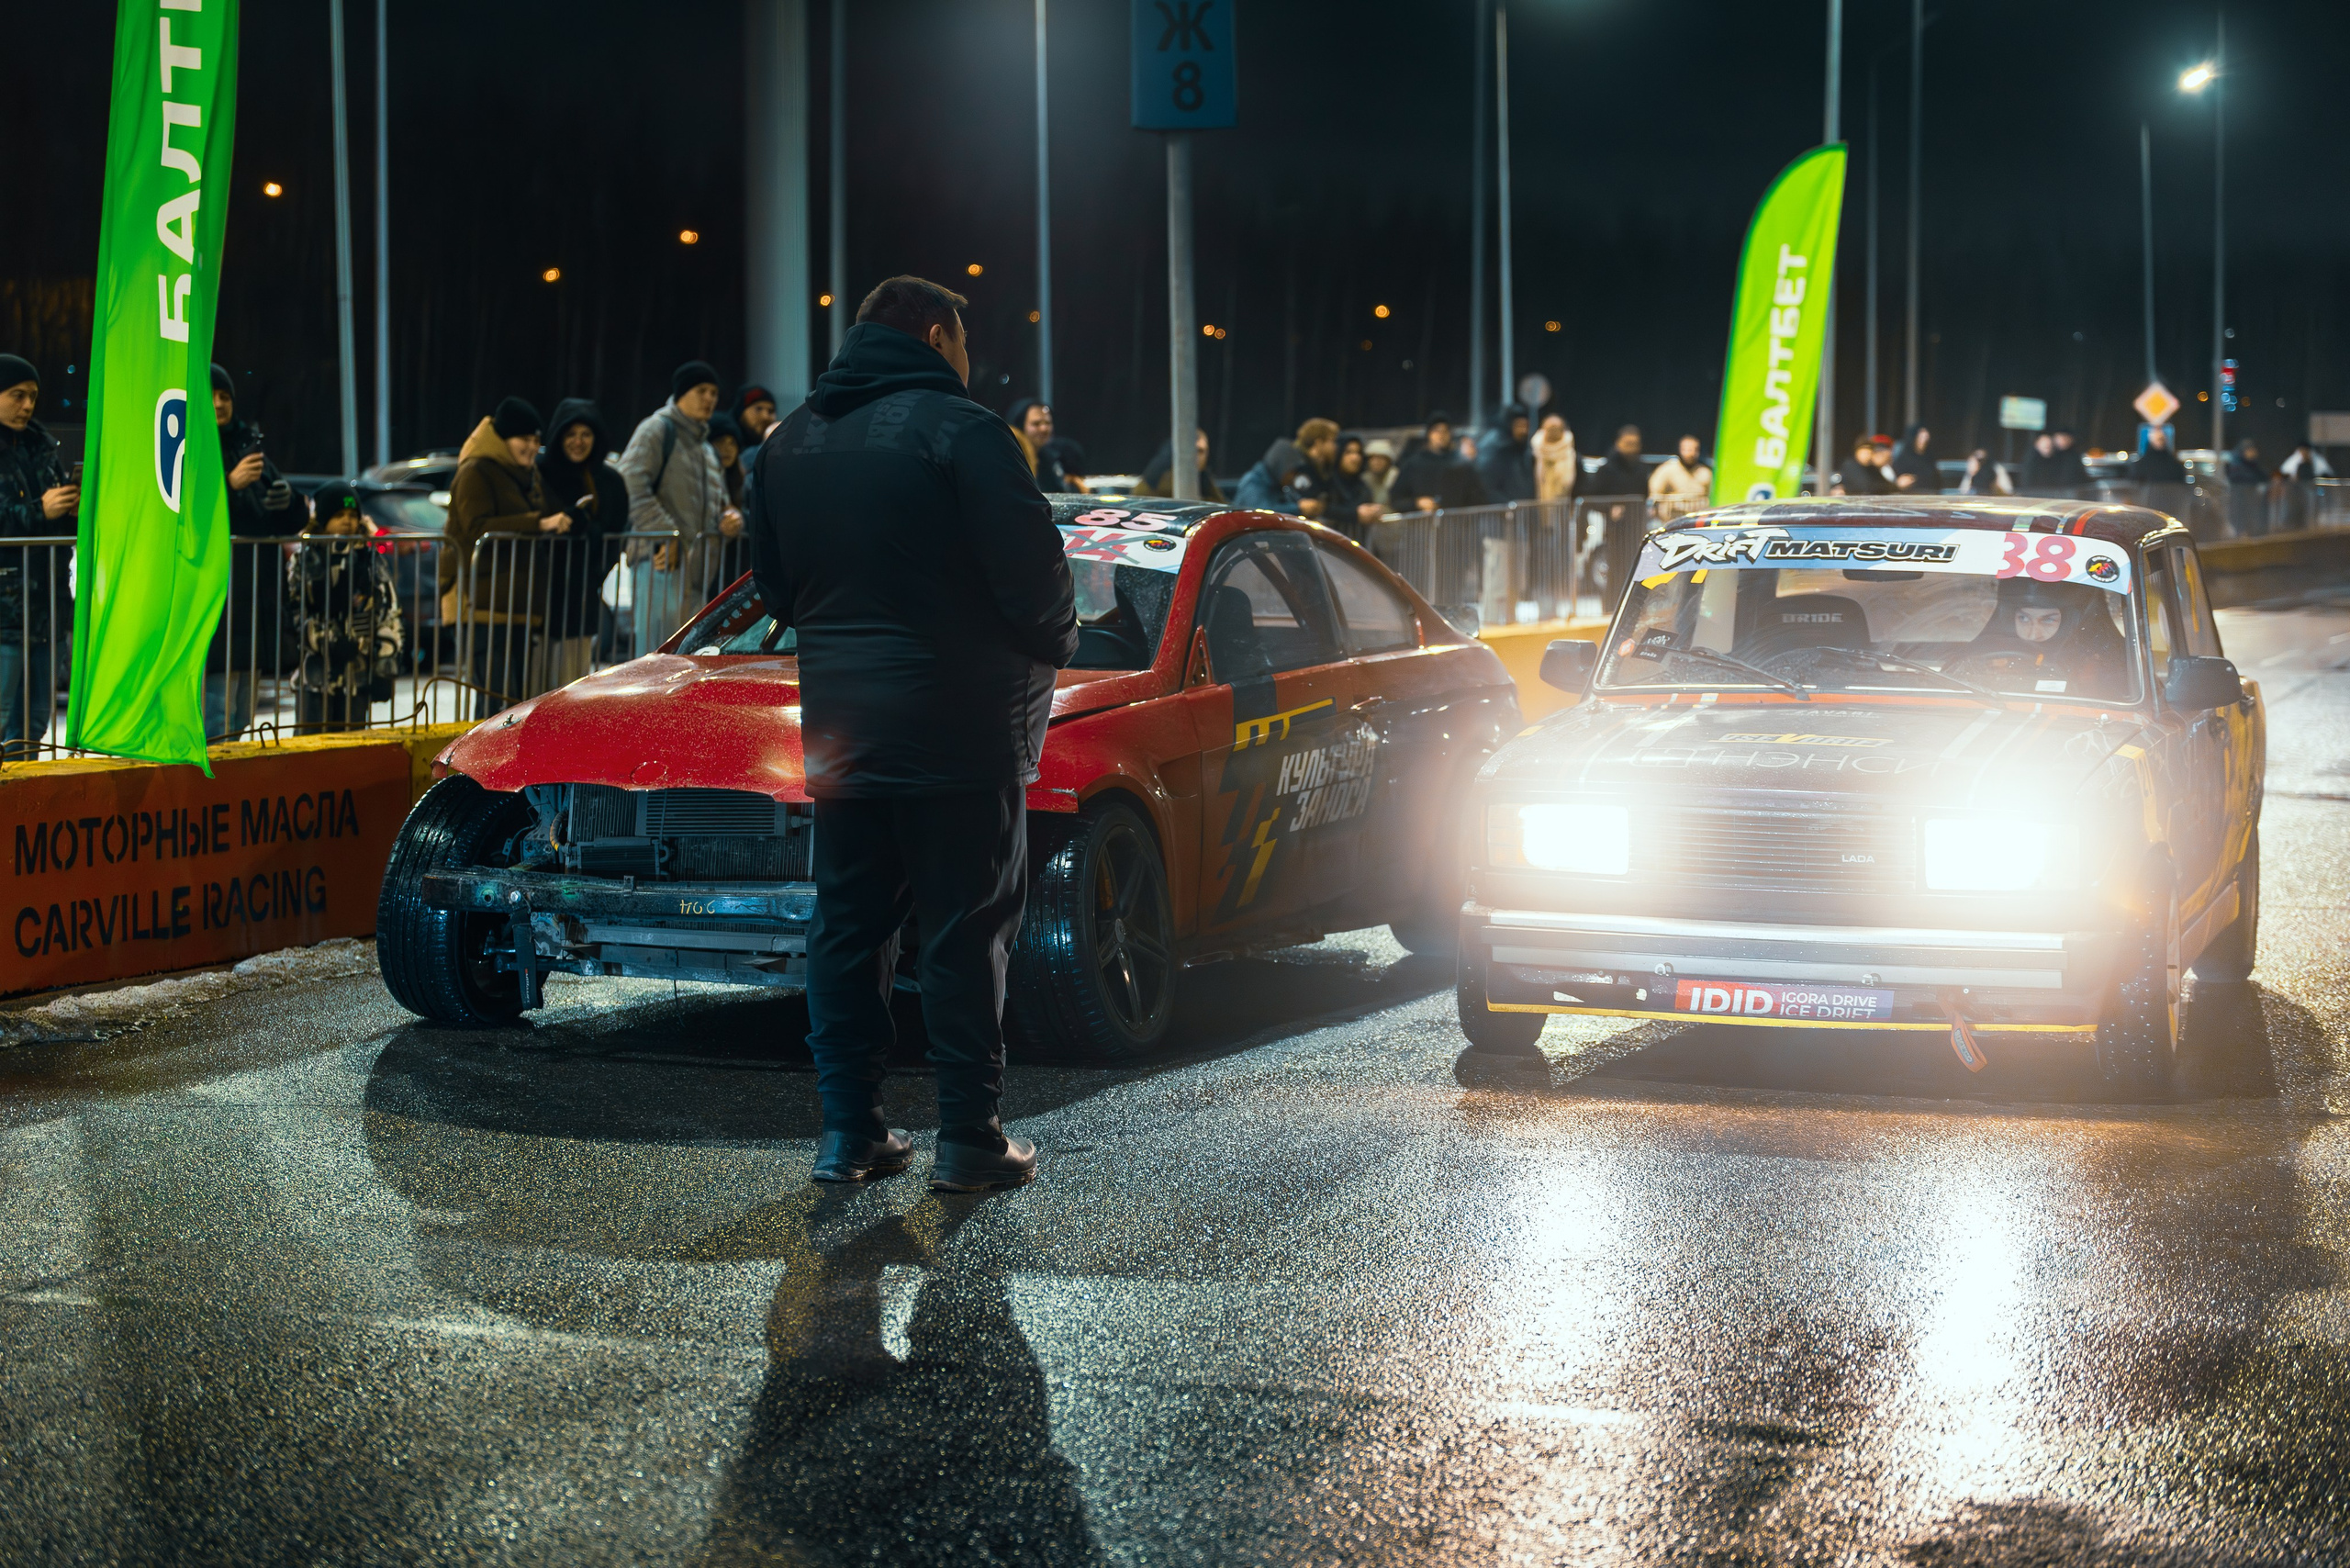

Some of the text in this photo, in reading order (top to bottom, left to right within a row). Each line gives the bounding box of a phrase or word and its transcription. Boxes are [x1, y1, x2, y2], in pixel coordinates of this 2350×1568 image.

[1154, 0, 1214, 52] Ж
[1172, 61, 1203, 112] 8
[1755, 243, 1807, 467] БАЛТБЕТ
[1074, 509, 1178, 532] 85
[1764, 540, 1960, 563] MATSURI
[1996, 532, 2076, 582] 38
[1711, 750, 1940, 778] НЭНСИ
[1290, 777, 1372, 832] ЗАНОСА
[15, 789, 359, 876] МОТОРНЫЕ МАСЛА
[1841, 855, 1874, 863] LADA
[15, 865, 327, 958] CARVILLE RACING
[1689, 987, 1774, 1015] IDID
[1779, 1003, 1876, 1019] ICE DRIFT
[1782, 991, 1877, 1008] IGORA DRIVE
